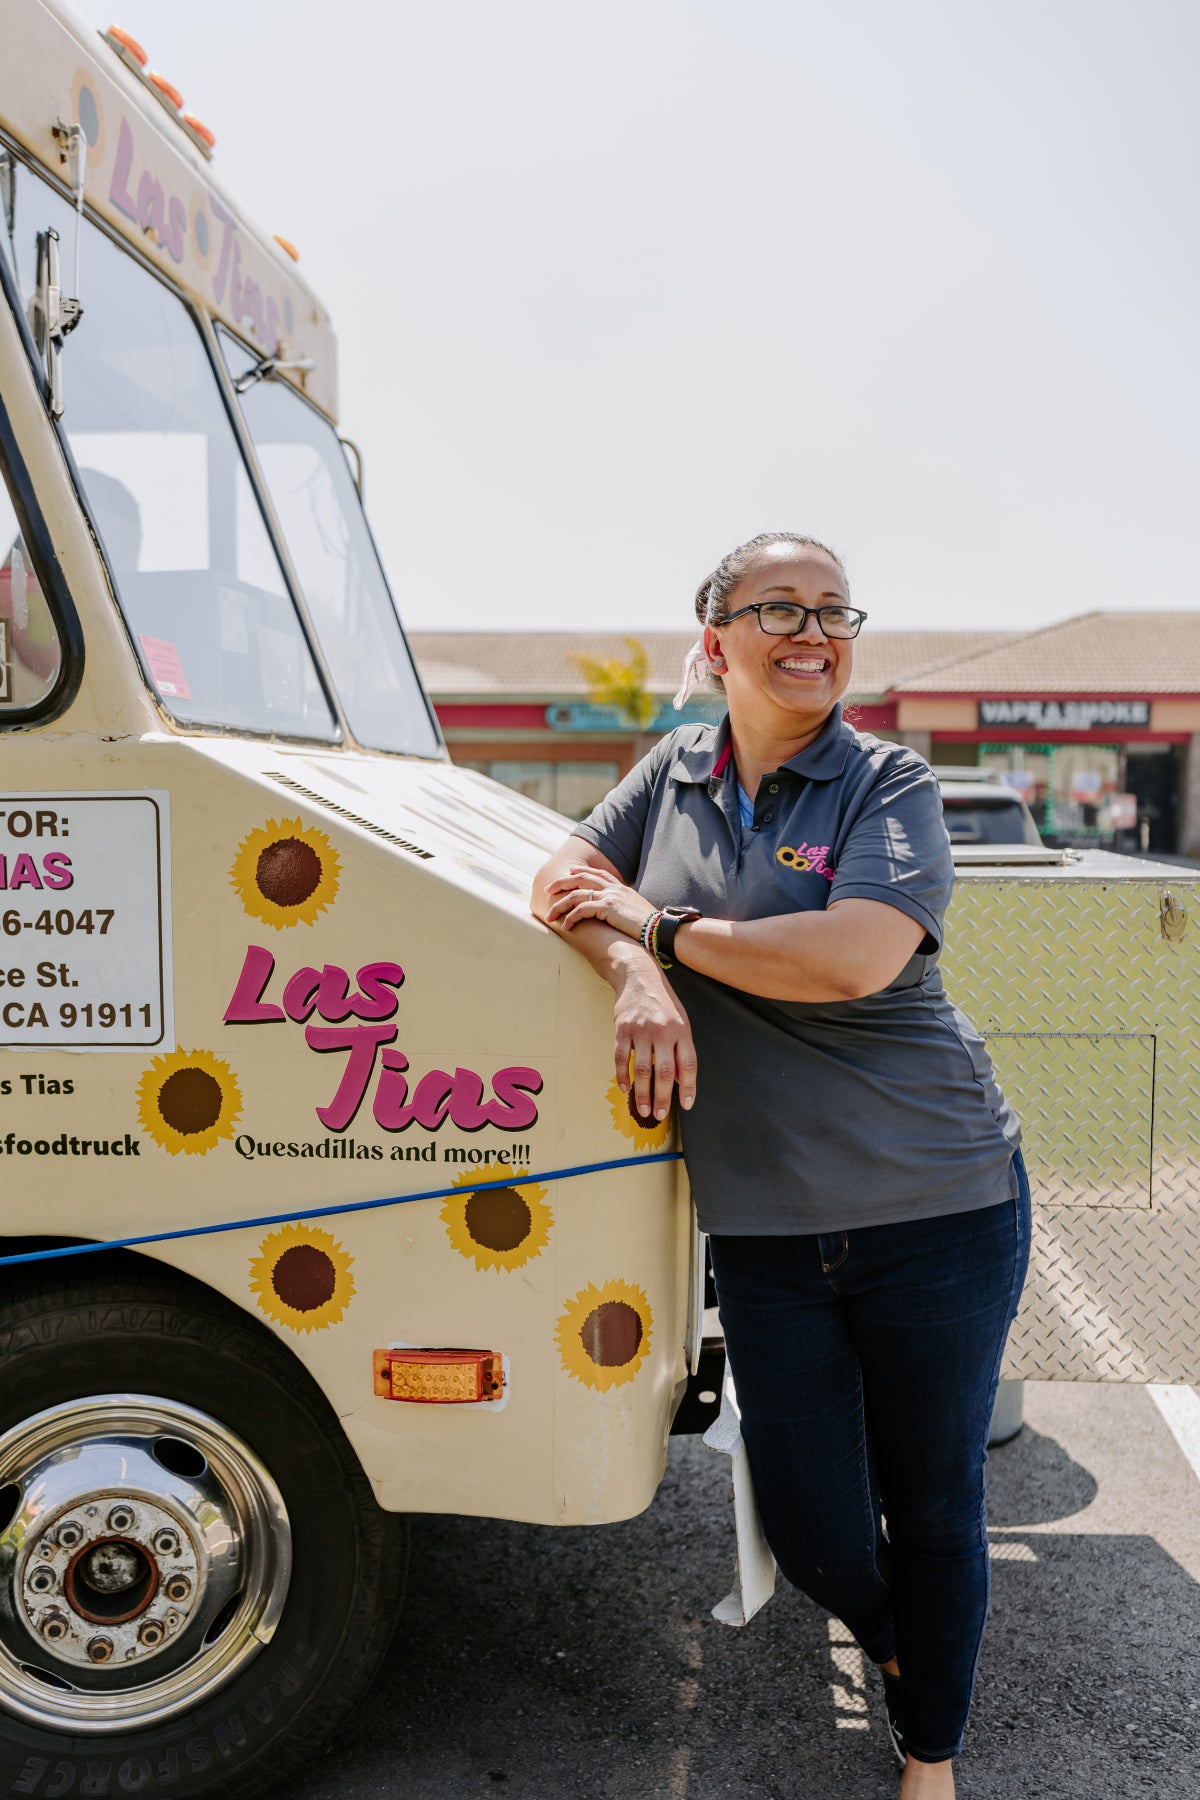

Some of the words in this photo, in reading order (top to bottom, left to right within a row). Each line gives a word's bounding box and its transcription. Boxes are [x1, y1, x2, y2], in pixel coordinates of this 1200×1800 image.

[108, 114, 186, 265] Las
[980, 701, 1042, 722] VAPE
[0, 810, 69, 837] OR:
[796, 841, 830, 856] Las
[805, 855, 836, 880] Tia
[36, 961, 79, 988] St.
[222, 945, 405, 1025] Las
[2, 1001, 50, 1028] CA
[59, 1002, 151, 1028] 91911
[20, 1073, 75, 1095] Tias
[304, 1023, 543, 1133] Tias
[234, 1134, 384, 1160] Quesadillas
[390, 1141, 437, 1162] and
[443, 1143, 531, 1166] more!!!
